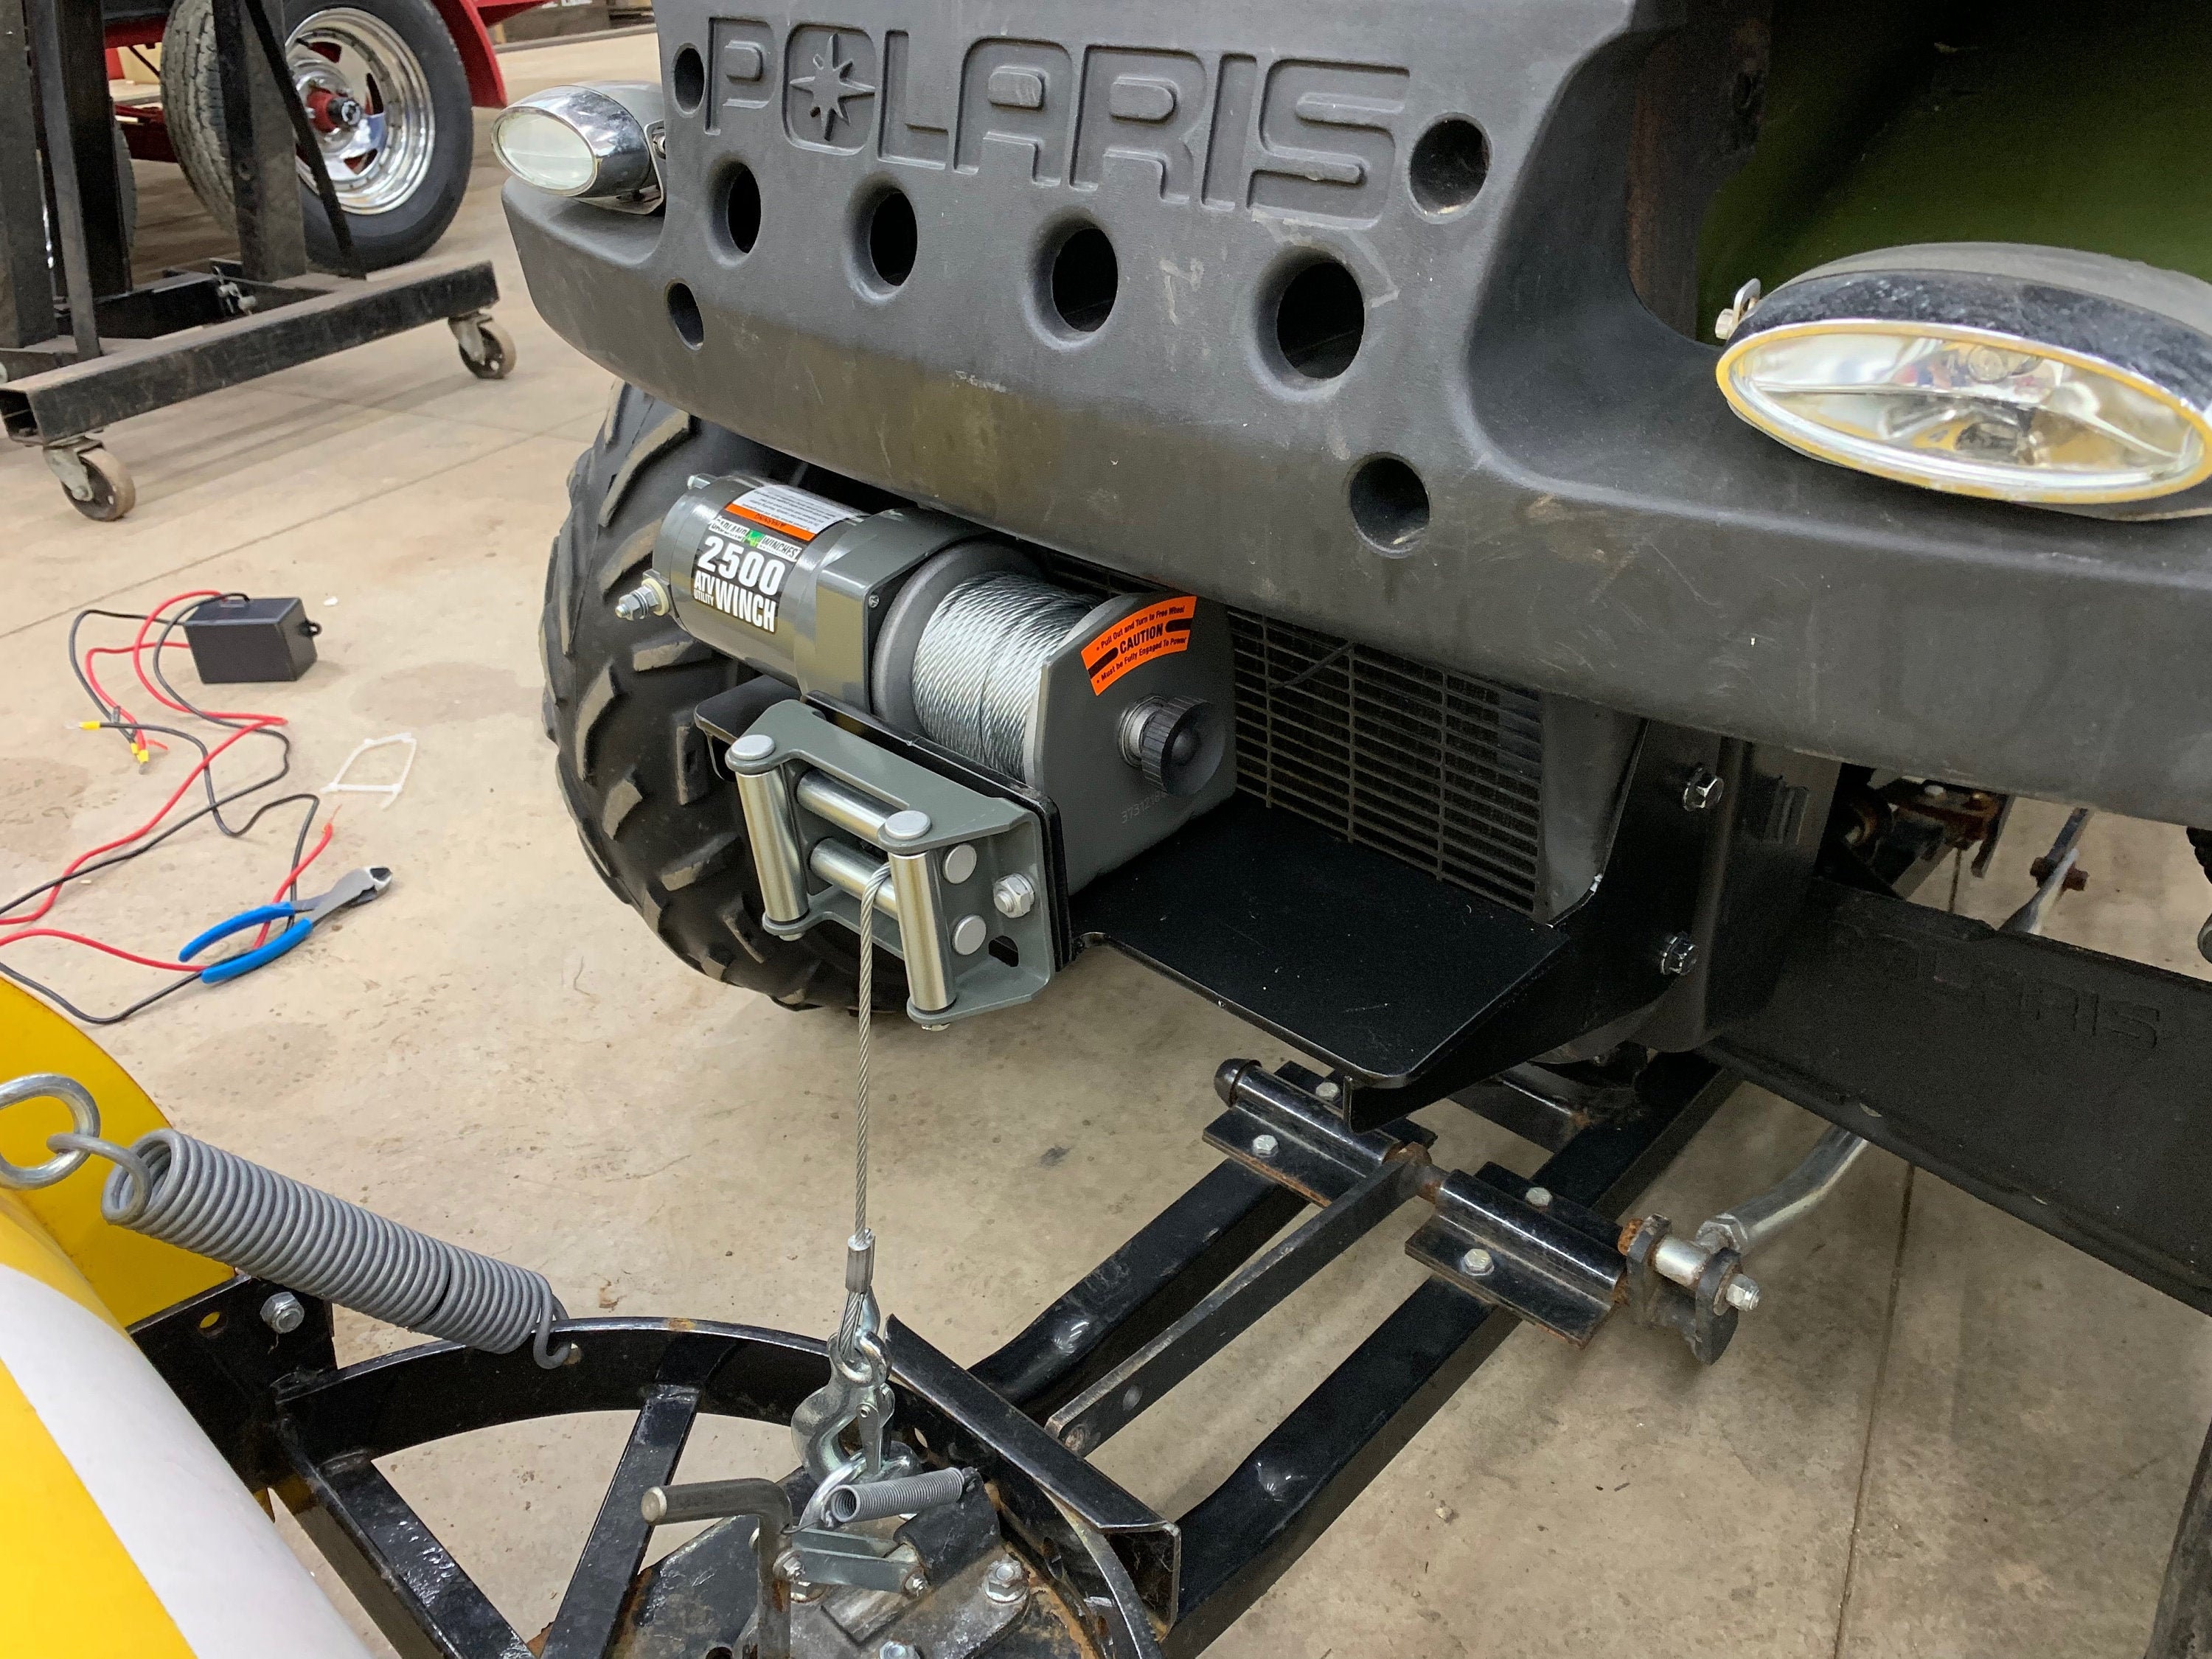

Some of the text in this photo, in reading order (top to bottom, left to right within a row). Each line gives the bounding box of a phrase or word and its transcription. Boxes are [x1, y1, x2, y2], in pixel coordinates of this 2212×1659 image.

[705, 16, 1411, 229] POLARIS
[698, 535, 785, 596] 2500
[694, 588, 714, 606] UTILITY
[694, 570, 776, 633] ATV WINCH
[1101, 635, 1112, 649] Pull
[1113, 627, 1123, 640] Out
[1124, 621, 1134, 633] and
[1135, 616, 1148, 627] Turn
[1156, 610, 1168, 619] Free
[1119, 622, 1164, 654] CAUTION
[1101, 666, 1115, 681] Must
[1116, 661, 1123, 670] be
[1124, 652, 1138, 664] Fully
[1138, 640, 1163, 656] Engaged
